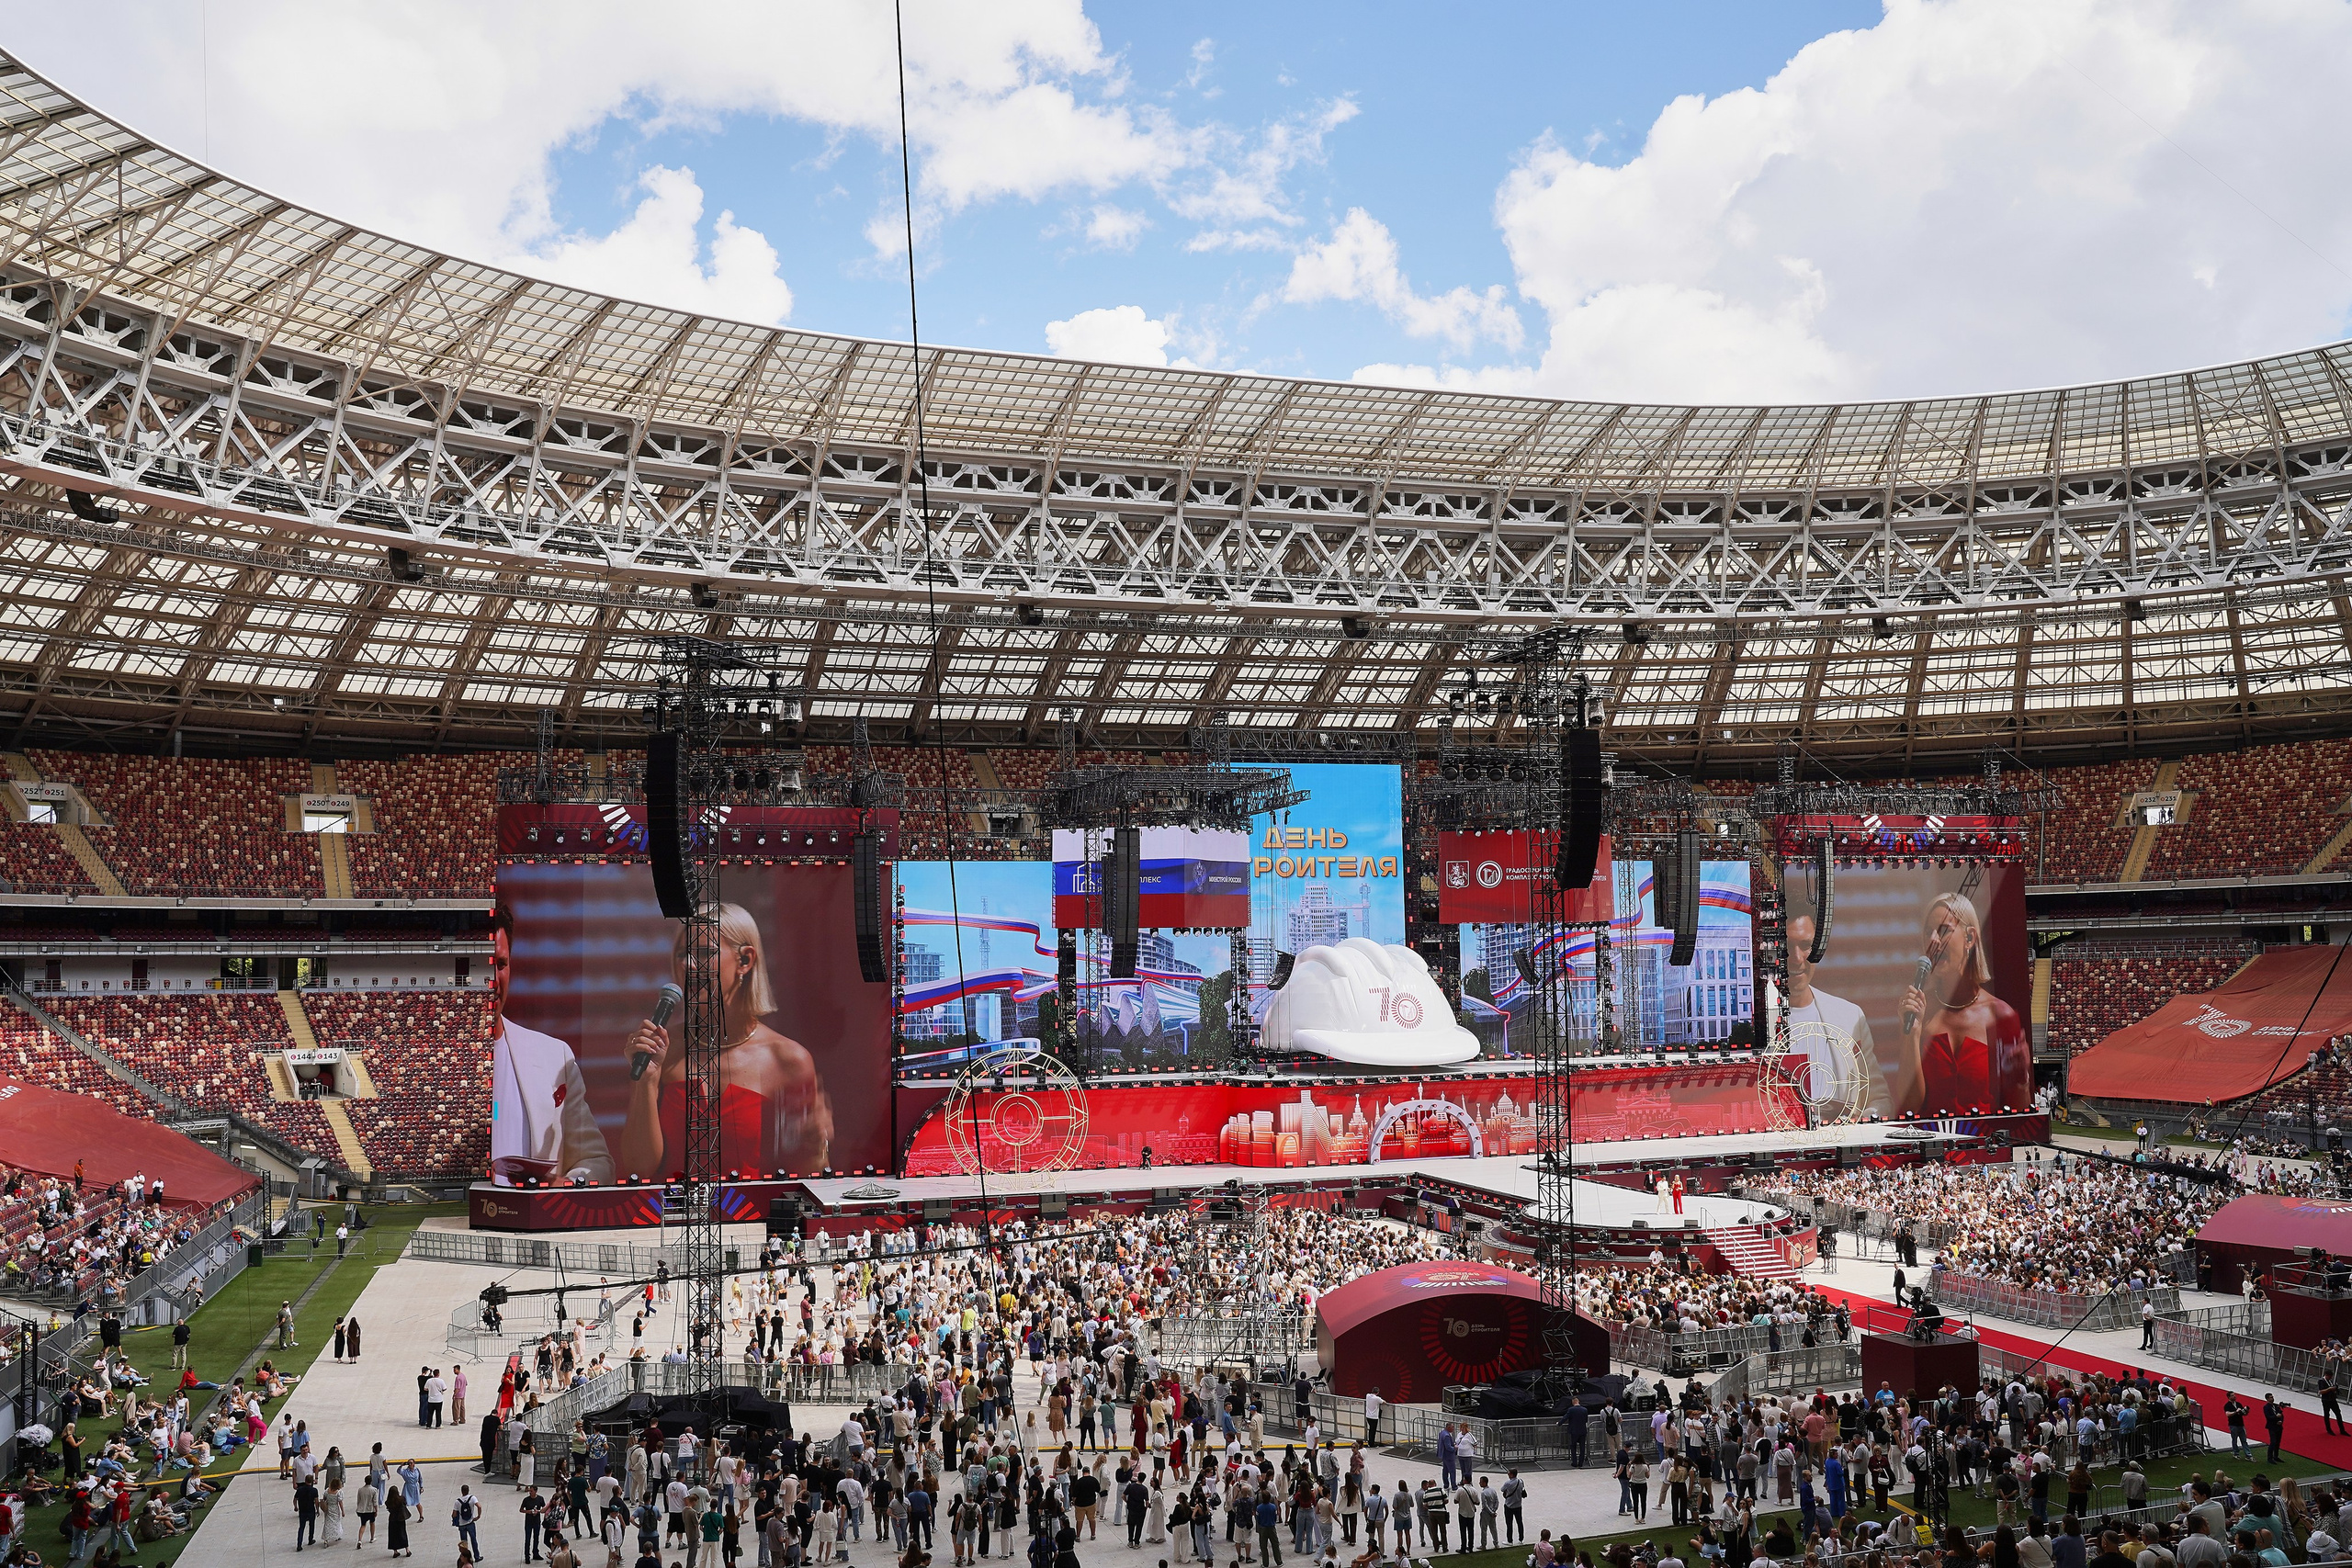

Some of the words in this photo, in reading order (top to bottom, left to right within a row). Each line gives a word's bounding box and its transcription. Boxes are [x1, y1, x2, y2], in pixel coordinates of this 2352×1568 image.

[1262, 828, 1349, 849] ДЕНЬ
[1250, 856, 1397, 877] РОИТЕЛЯ
[1368, 987, 1423, 1030] 70
[480, 1198, 498, 1218] 70
[1443, 1317, 1470, 1337] 70
